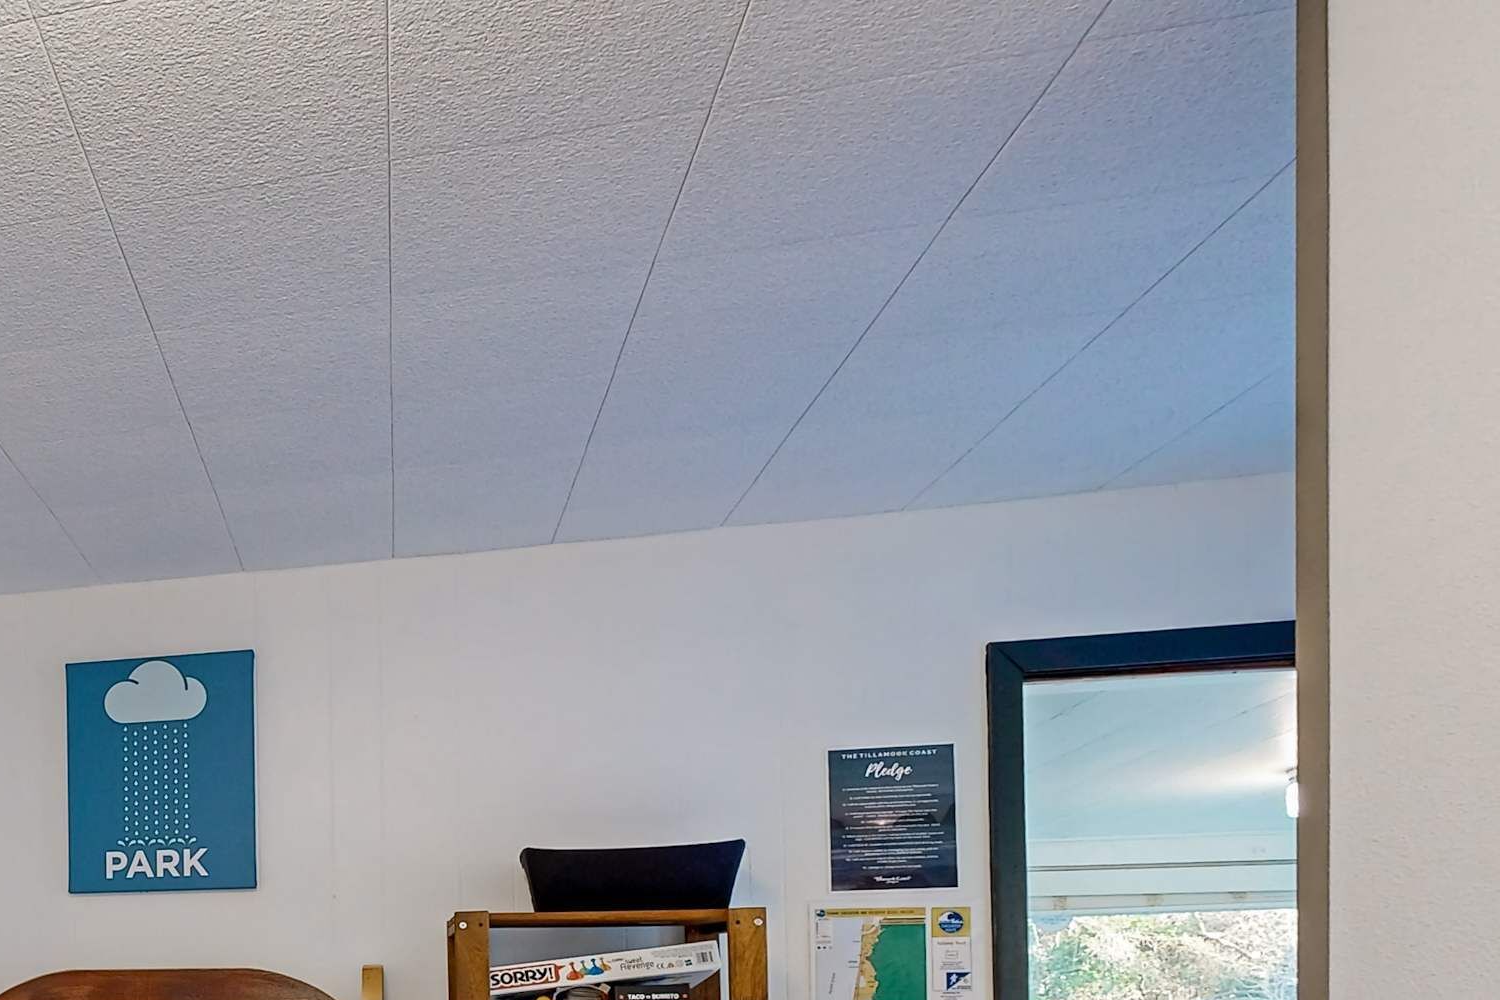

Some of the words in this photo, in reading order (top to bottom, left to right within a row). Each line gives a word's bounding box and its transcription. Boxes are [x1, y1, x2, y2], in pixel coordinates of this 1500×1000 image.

[859, 751, 908, 759] TILLAMOOK
[864, 761, 913, 781] Pledge
[105, 848, 209, 879] PARK
[490, 967, 554, 987] SORRY!
